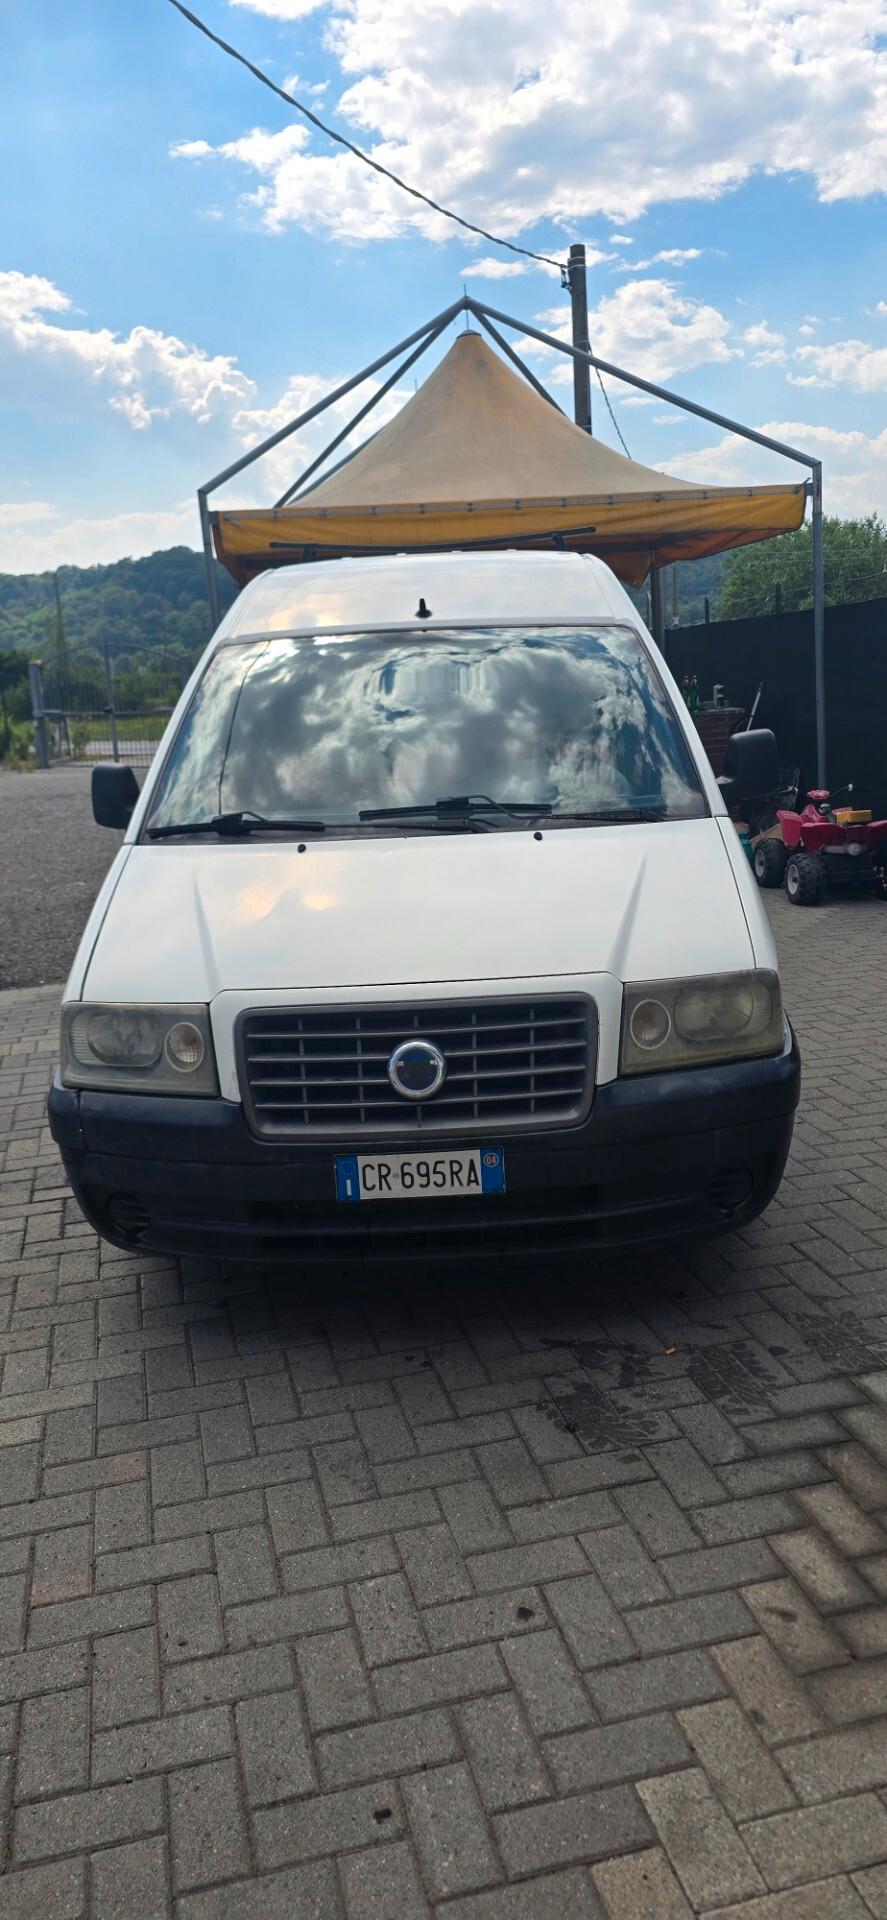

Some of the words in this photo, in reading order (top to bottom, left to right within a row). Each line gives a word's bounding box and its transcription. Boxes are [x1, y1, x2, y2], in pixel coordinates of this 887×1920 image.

[361, 1163, 392, 1191] CR
[400, 1158, 480, 1189] 695RA
[346, 1179, 352, 1196] I
